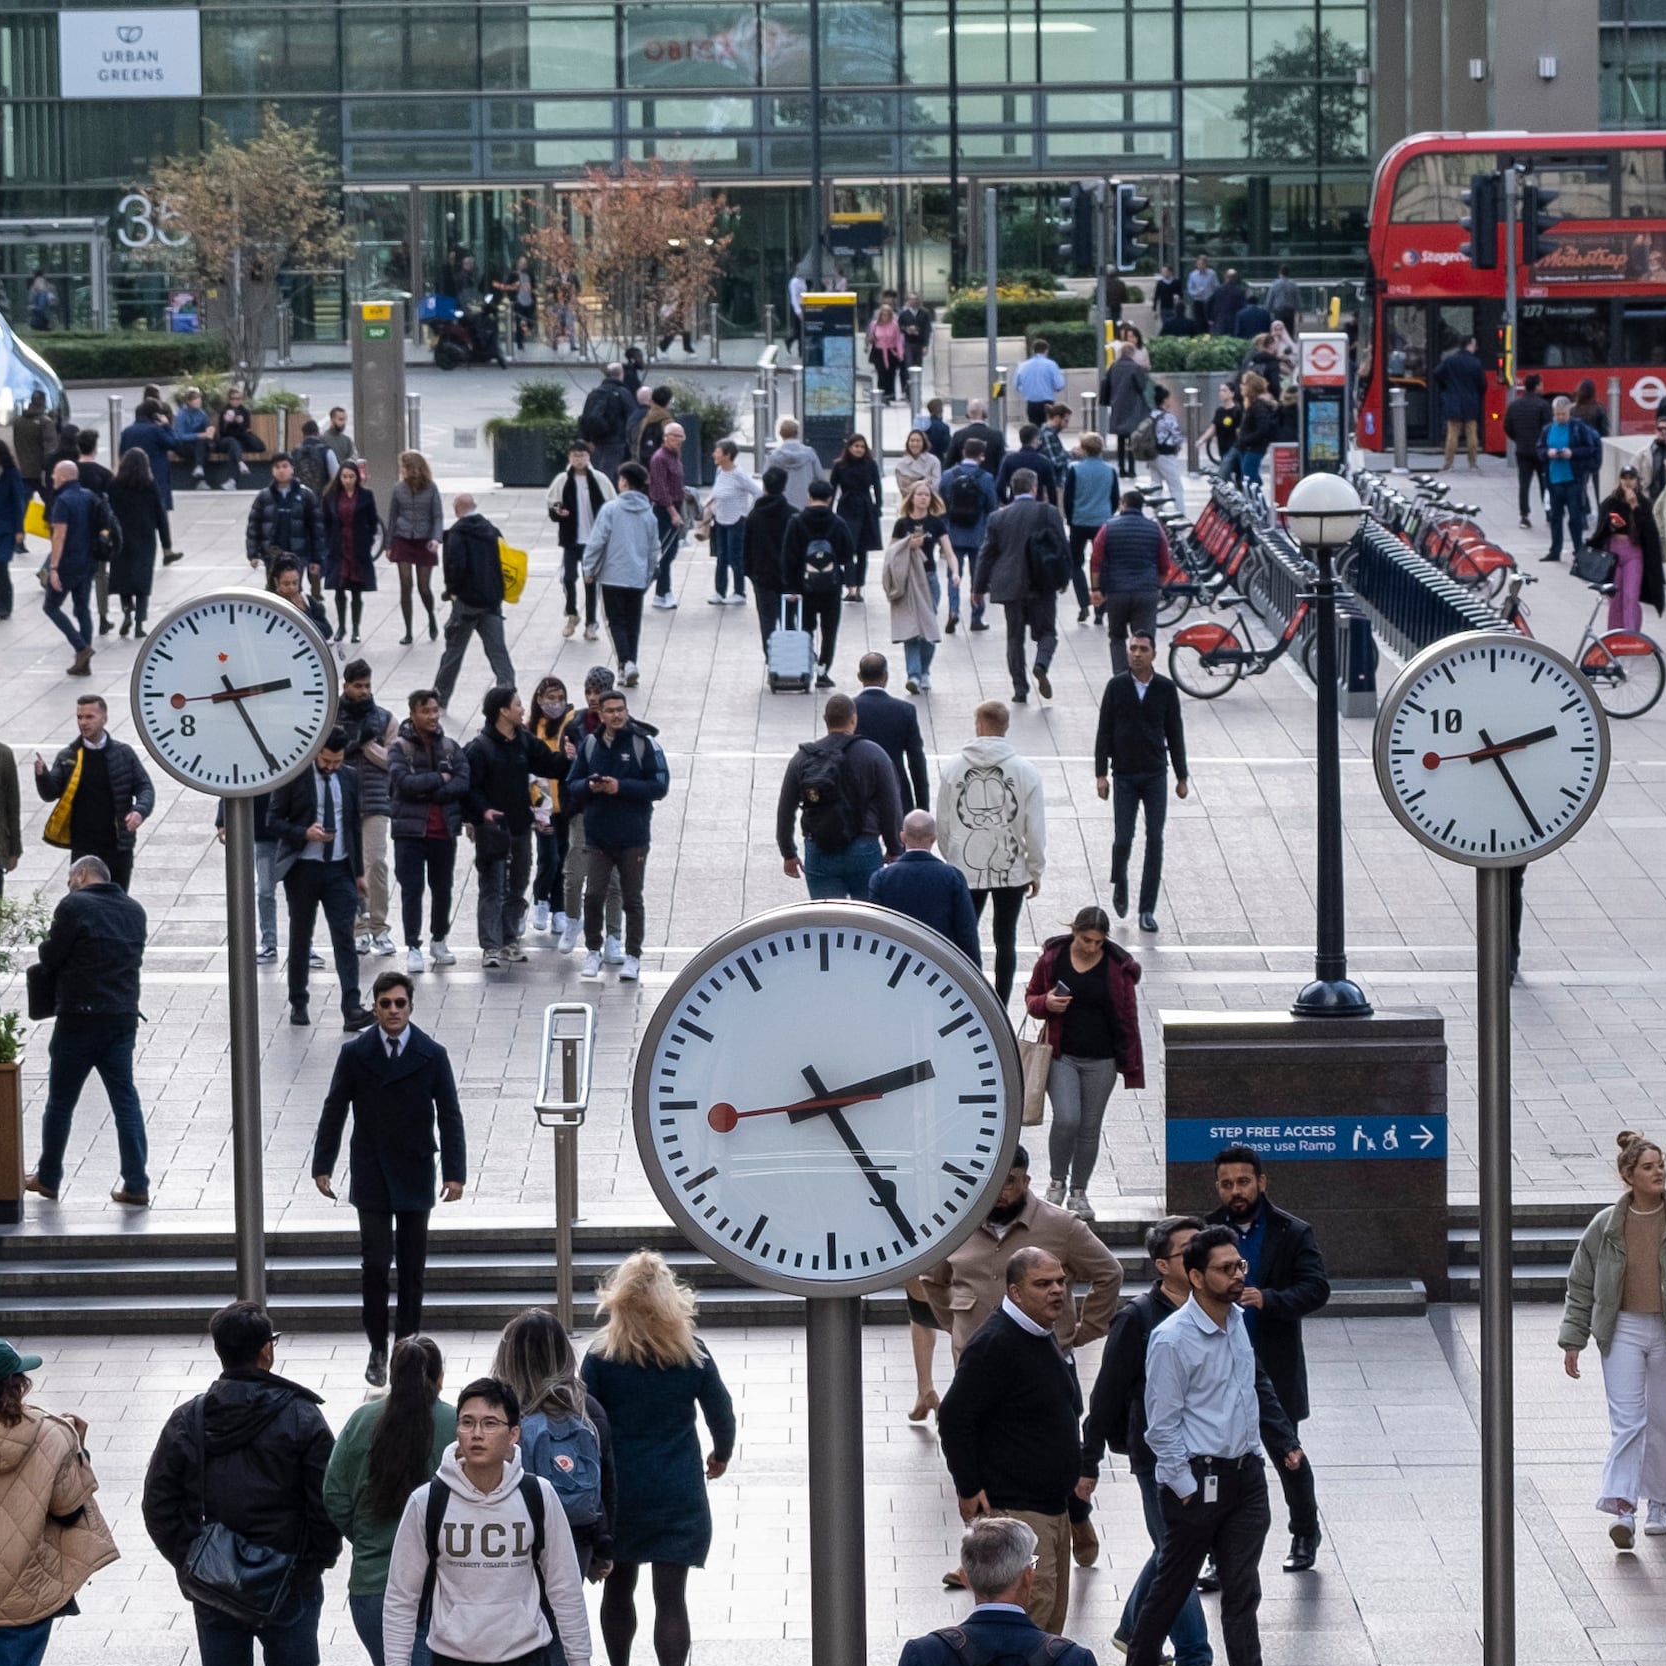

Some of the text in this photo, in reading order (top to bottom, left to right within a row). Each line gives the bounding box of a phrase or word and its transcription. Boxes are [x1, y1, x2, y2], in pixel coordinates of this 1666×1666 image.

[102, 49, 159, 63] URBAN
[98, 68, 164, 82] GREENS
[1533, 247, 1628, 271] Mousetrap
[179, 714, 196, 737] 8
[1430, 708, 1463, 735] 10
[1209, 1125, 1336, 1139] STEP FREE ACCESS
[1274, 1142, 1296, 1152] use
[1298, 1140, 1337, 1153] Ramp
[443, 1522, 530, 1558] UCL
